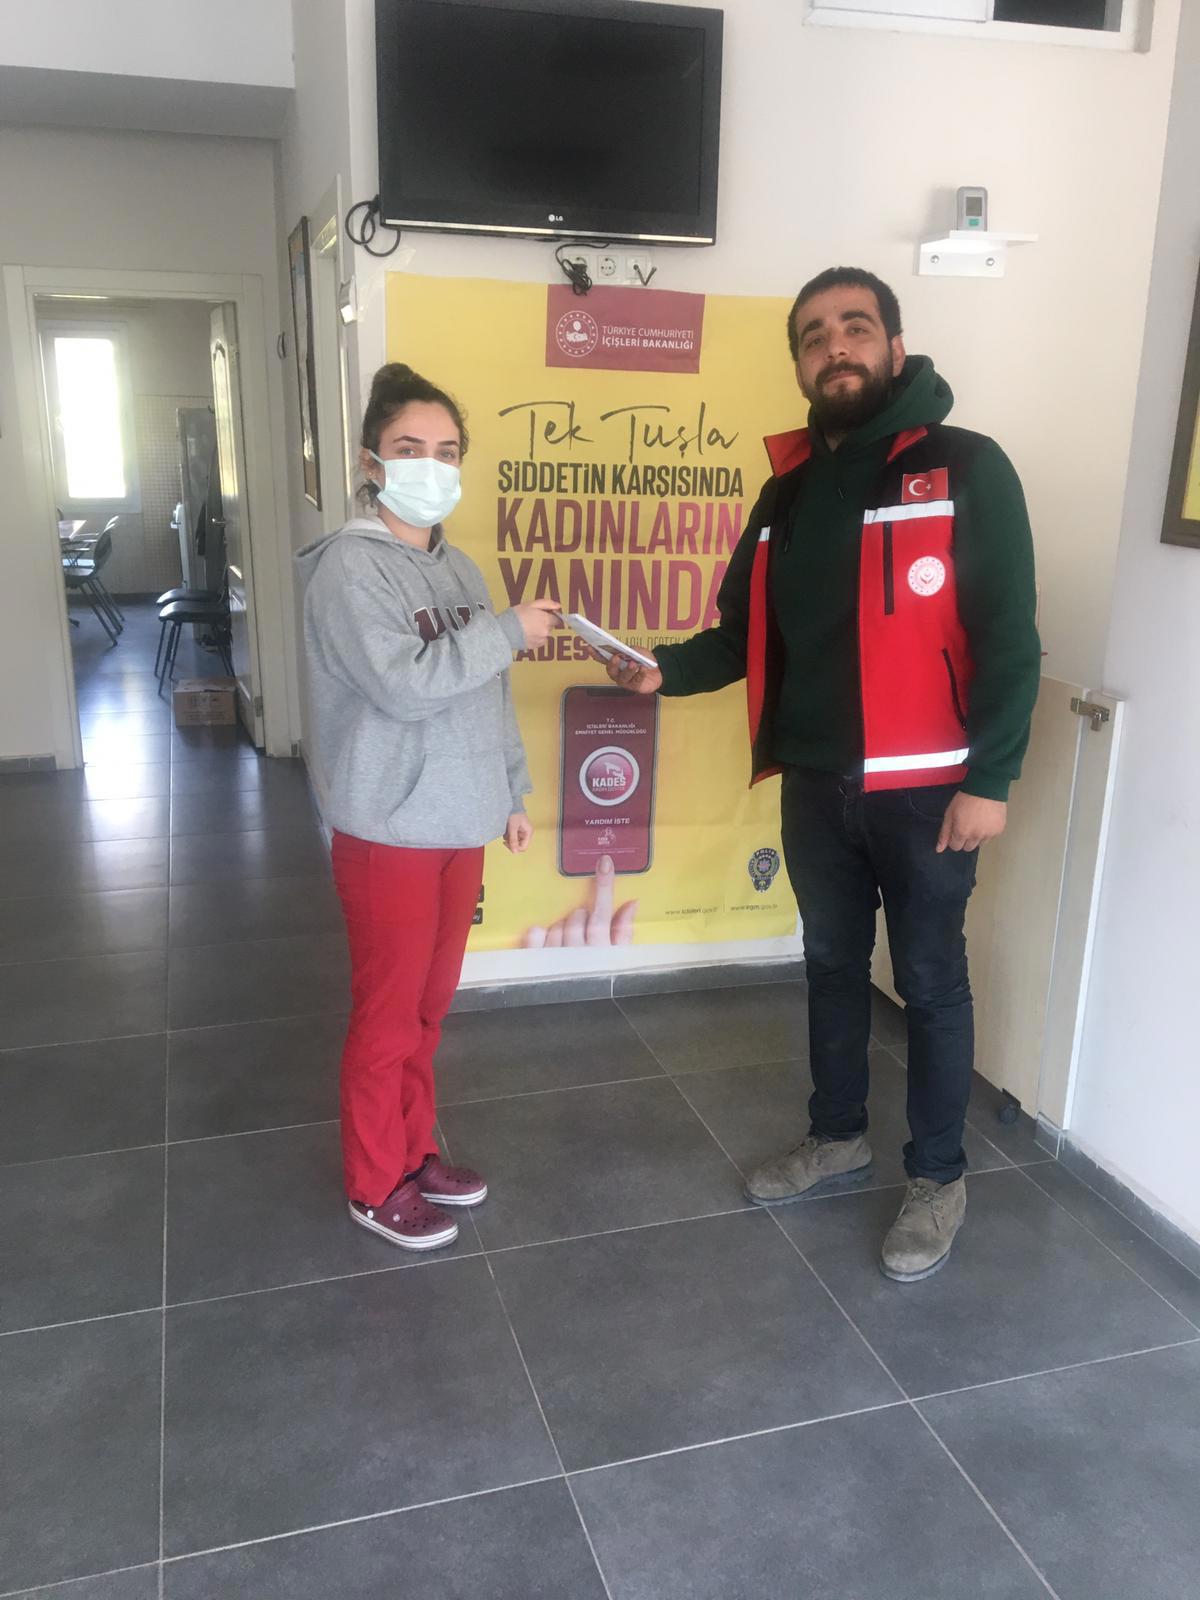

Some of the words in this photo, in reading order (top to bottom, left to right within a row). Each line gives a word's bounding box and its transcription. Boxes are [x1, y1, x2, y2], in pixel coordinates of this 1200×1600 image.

[602, 336, 640, 348] İÇİŞLERİ
[643, 337, 693, 350] BAKANLIĞI
[498, 400, 594, 461] Tek
[600, 401, 739, 464] Tuşla
[498, 460, 606, 494] ŞİDDETİN
[612, 463, 744, 498] KARŞISINDA
[497, 497, 743, 556] KADINLARIN
[498, 558, 728, 631] YANINDA
